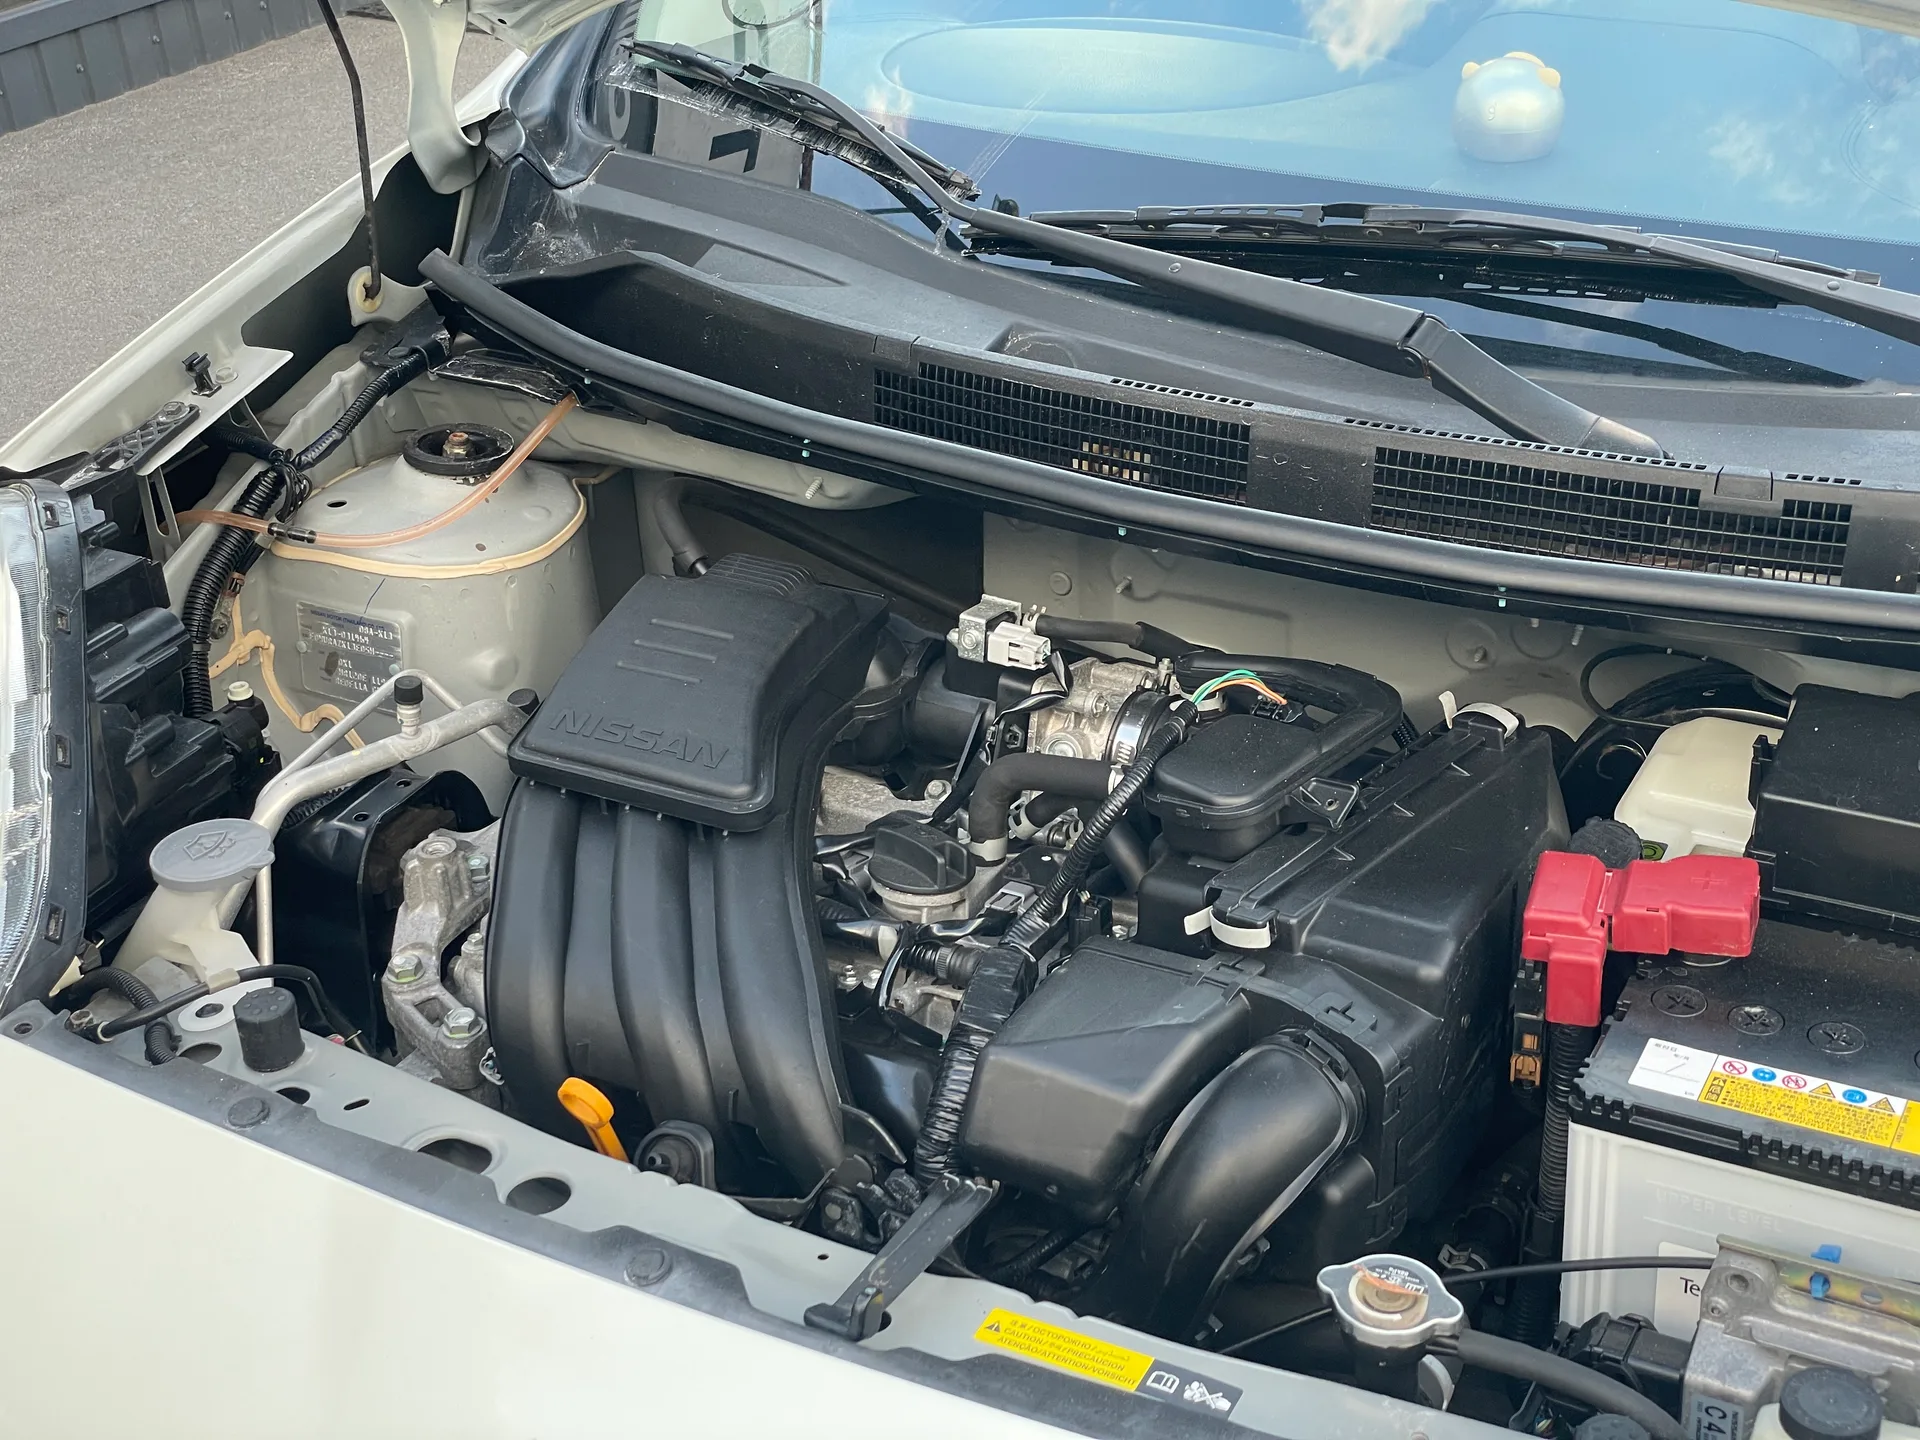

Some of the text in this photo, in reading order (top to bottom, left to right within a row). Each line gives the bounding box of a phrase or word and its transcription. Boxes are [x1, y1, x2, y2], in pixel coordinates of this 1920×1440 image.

[550, 706, 730, 769] NISSAN
[1656, 1187, 1782, 1233] UPPER LEVEL
